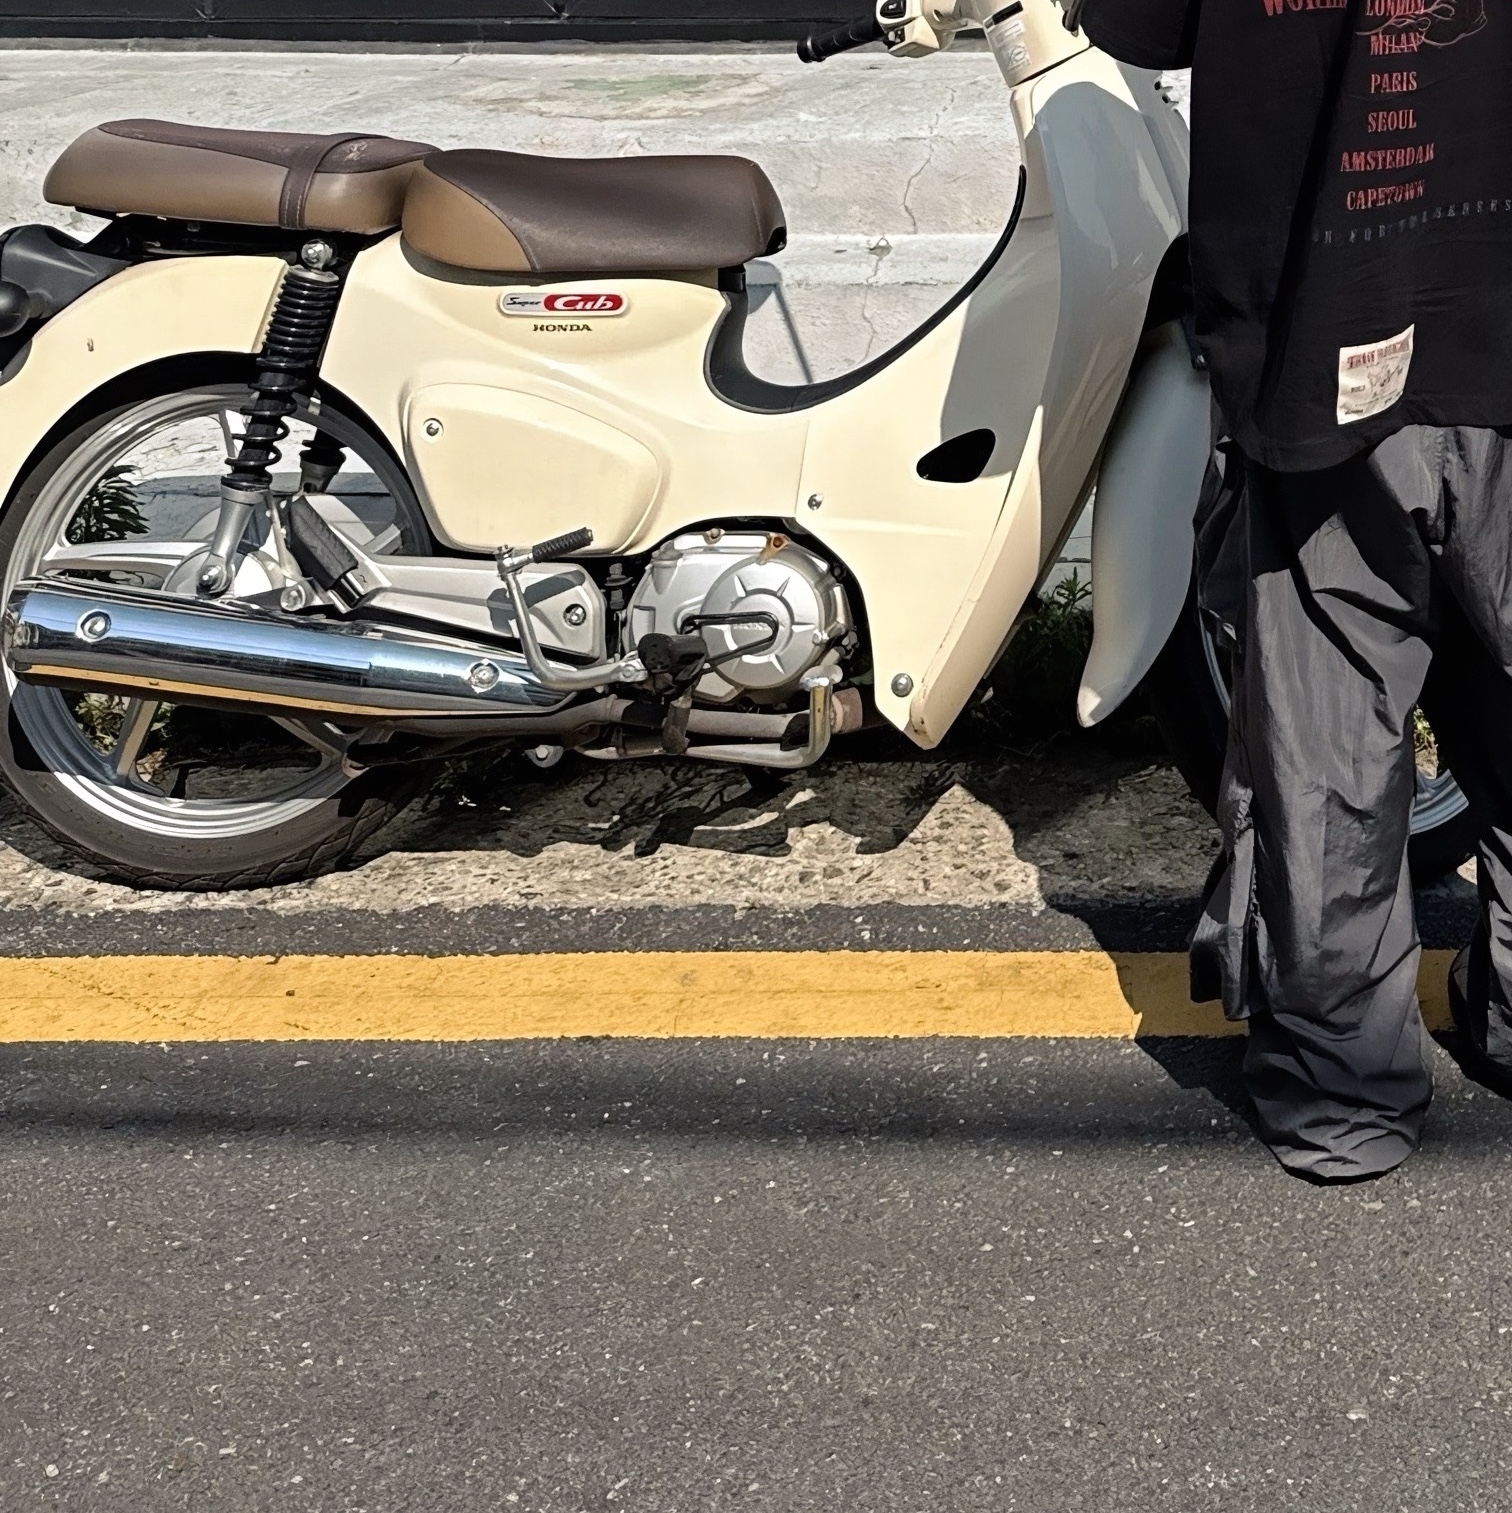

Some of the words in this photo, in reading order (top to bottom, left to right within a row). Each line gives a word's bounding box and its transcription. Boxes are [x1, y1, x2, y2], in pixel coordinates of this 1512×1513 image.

[1370, 32, 1421, 56] MILAN
[1370, 72, 1418, 94] PARIS
[1367, 109, 1417, 133] SEOUL
[1340, 143, 1435, 173] AMSTERDAM
[1346, 180, 1425, 211] CAPETOWN
[553, 295, 614, 311] Cub
[532, 323, 593, 332] HONDA
